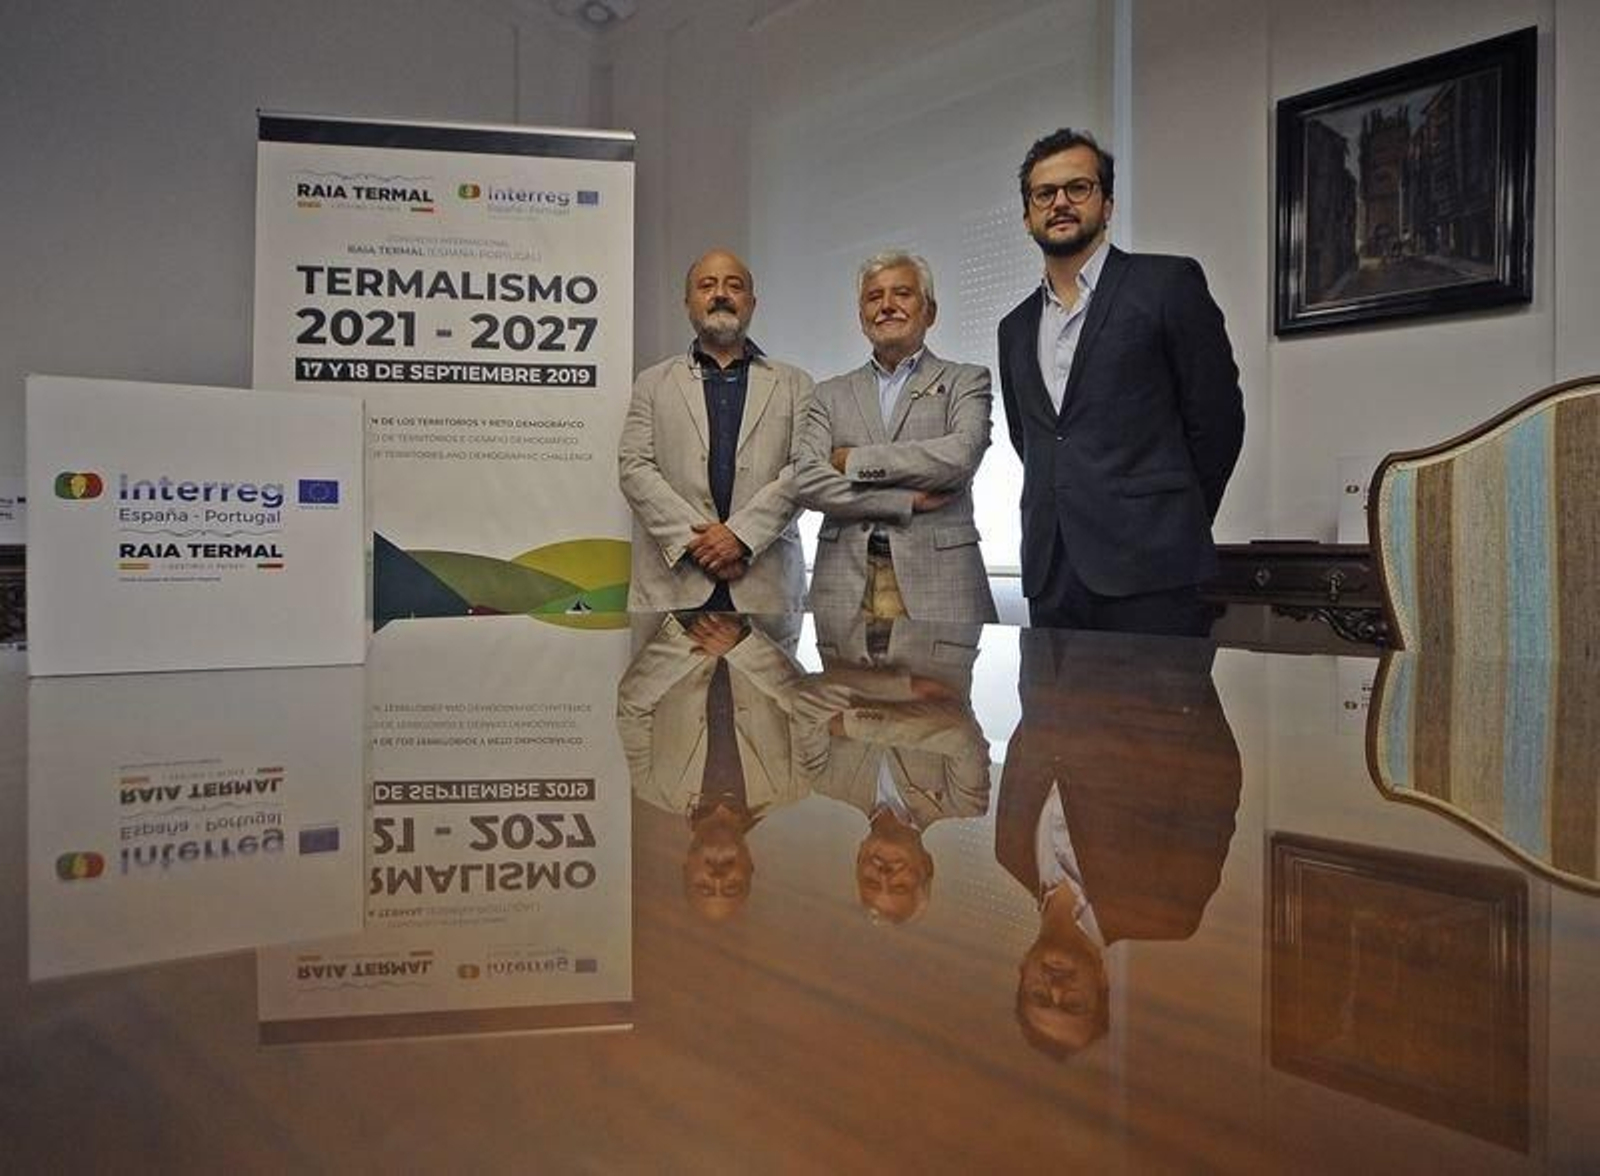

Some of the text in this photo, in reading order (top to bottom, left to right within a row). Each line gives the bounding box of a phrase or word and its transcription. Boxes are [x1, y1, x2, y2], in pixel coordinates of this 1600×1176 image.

[296, 182, 434, 203] RAIA TERMAL
[347, 244, 374, 255] RAIA
[379, 245, 424, 257] TERMAL
[296, 265, 598, 304] TERMALISMO
[296, 307, 598, 352] 2021 - 2027
[302, 361, 591, 385] 17 Y 18 DE SEPTIEMBRE 2019
[381, 417, 394, 426] DE
[397, 417, 415, 427] LOS
[118, 508, 188, 524] España
[205, 509, 281, 526] Portugal
[118, 543, 283, 559] RAIA TERMAL
